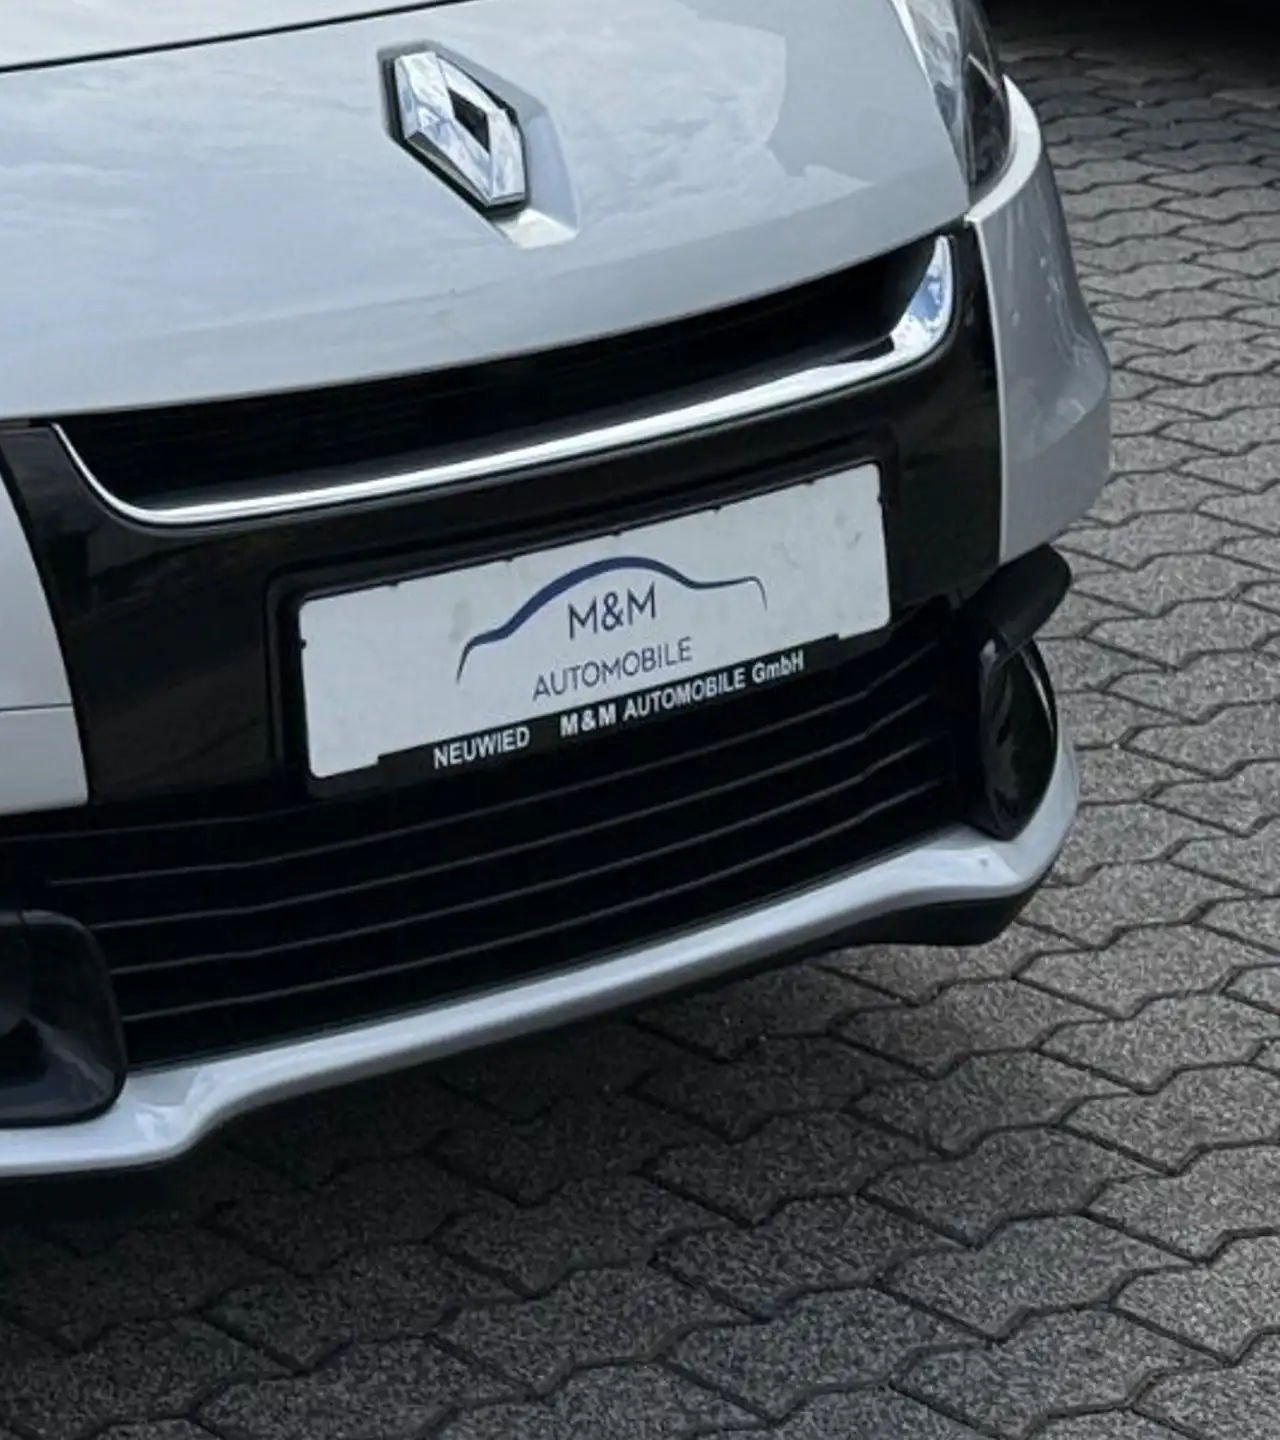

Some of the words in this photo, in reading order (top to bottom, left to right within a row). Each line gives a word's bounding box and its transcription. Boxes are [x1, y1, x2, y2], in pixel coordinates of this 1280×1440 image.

[567, 582, 657, 640] M&M
[532, 636, 693, 703] AUTOMOBILE
[432, 725, 532, 770] NEUWIED
[622, 668, 747, 723] AUTOMOBILE
[751, 649, 805, 687] GmbH
